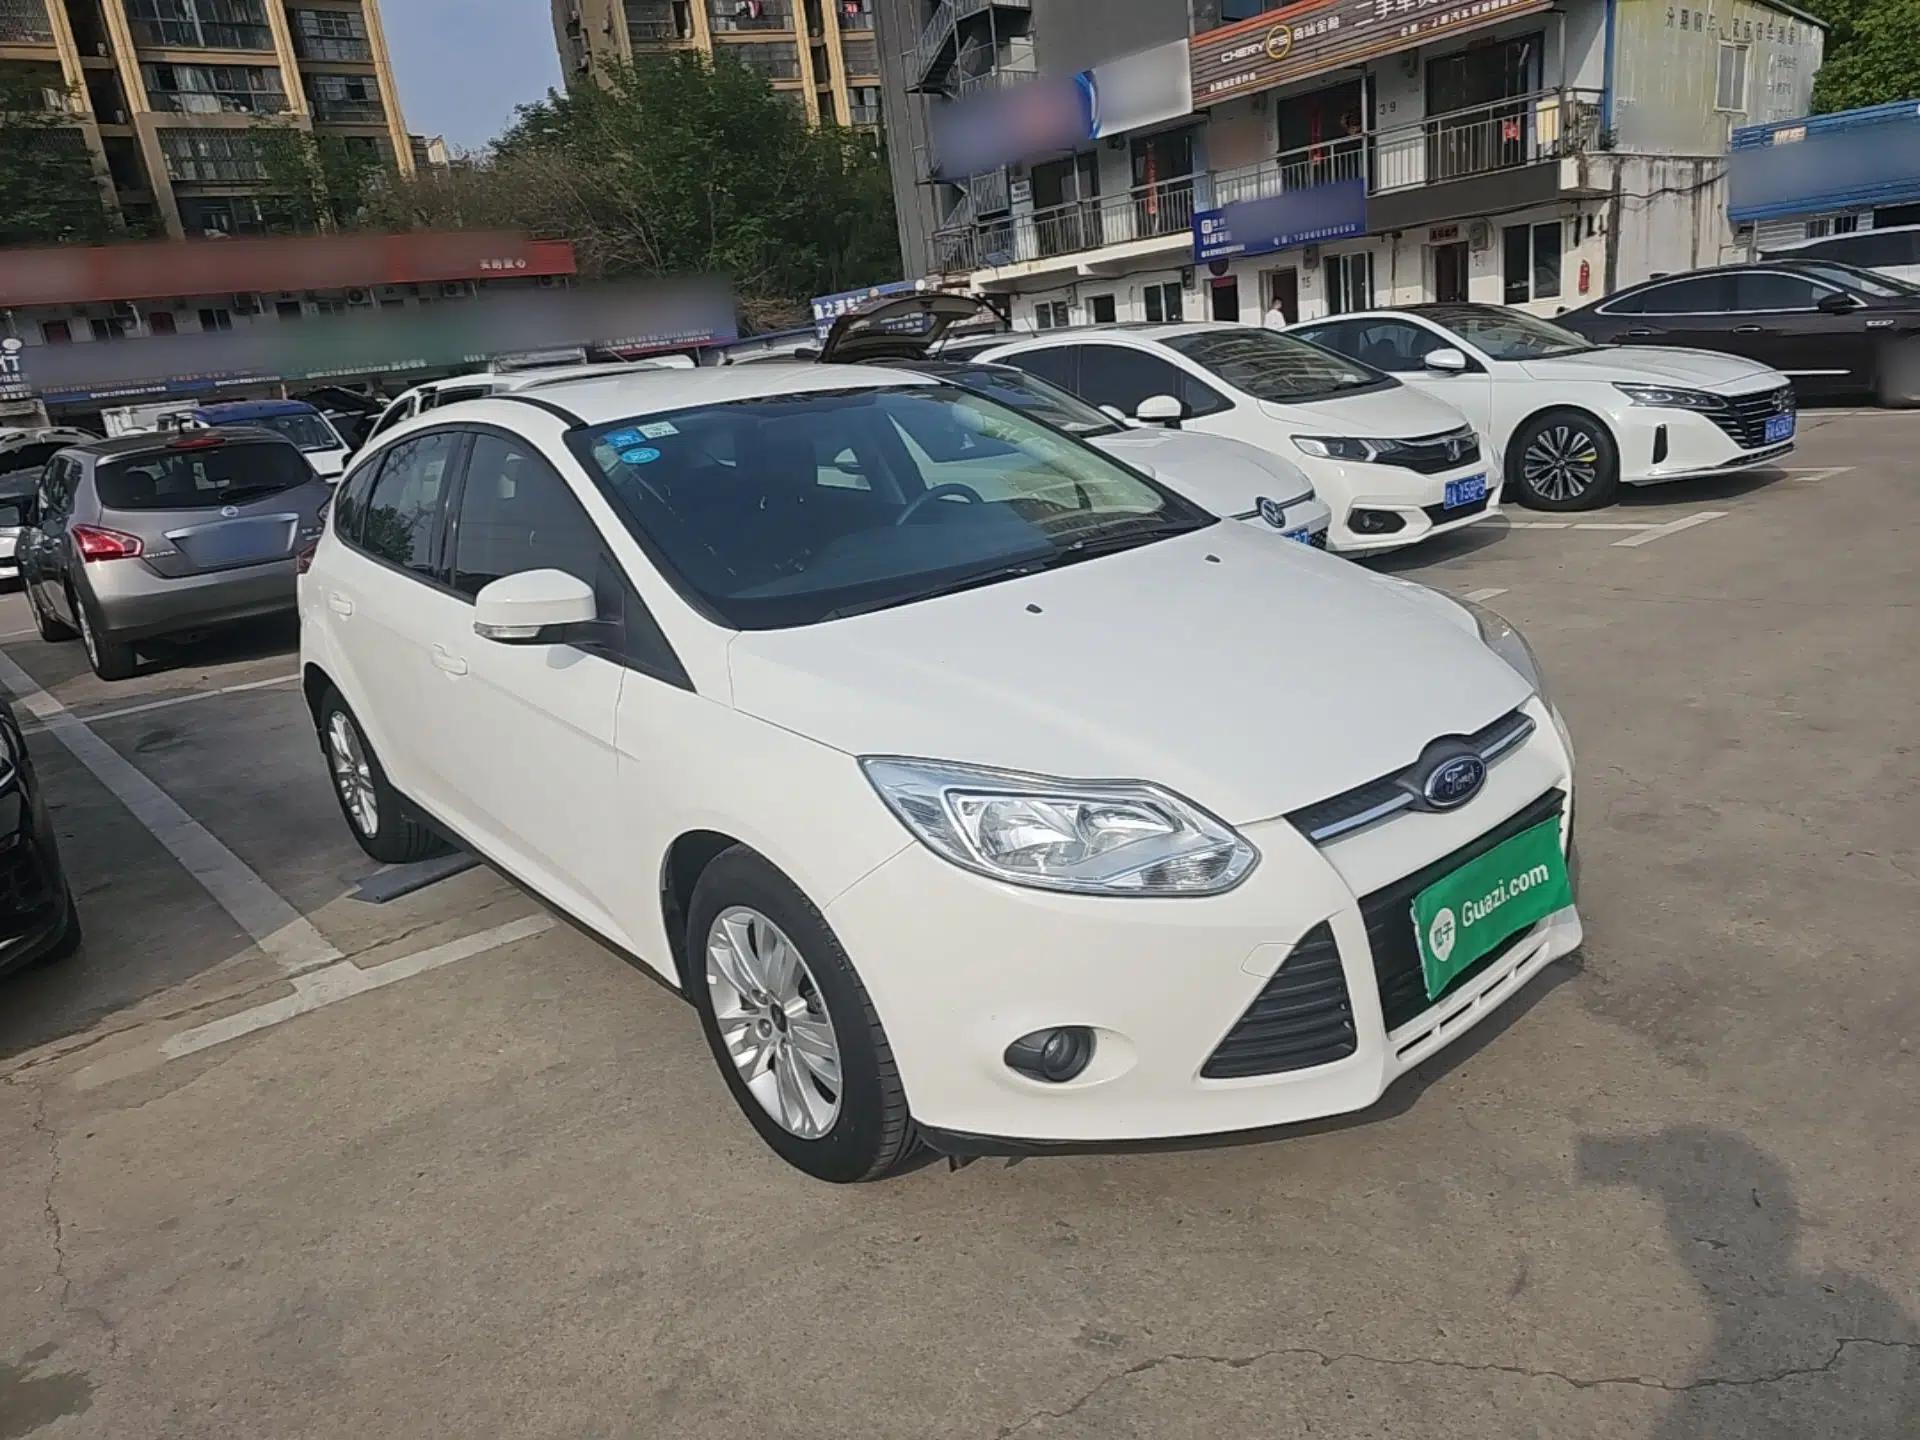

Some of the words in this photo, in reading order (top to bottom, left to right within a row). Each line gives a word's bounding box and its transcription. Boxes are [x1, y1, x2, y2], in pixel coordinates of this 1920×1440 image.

[1220, 42, 1265, 63] CHERY
[1445, 764, 1476, 795] Ford
[1461, 863, 1549, 928] Guazi.com
